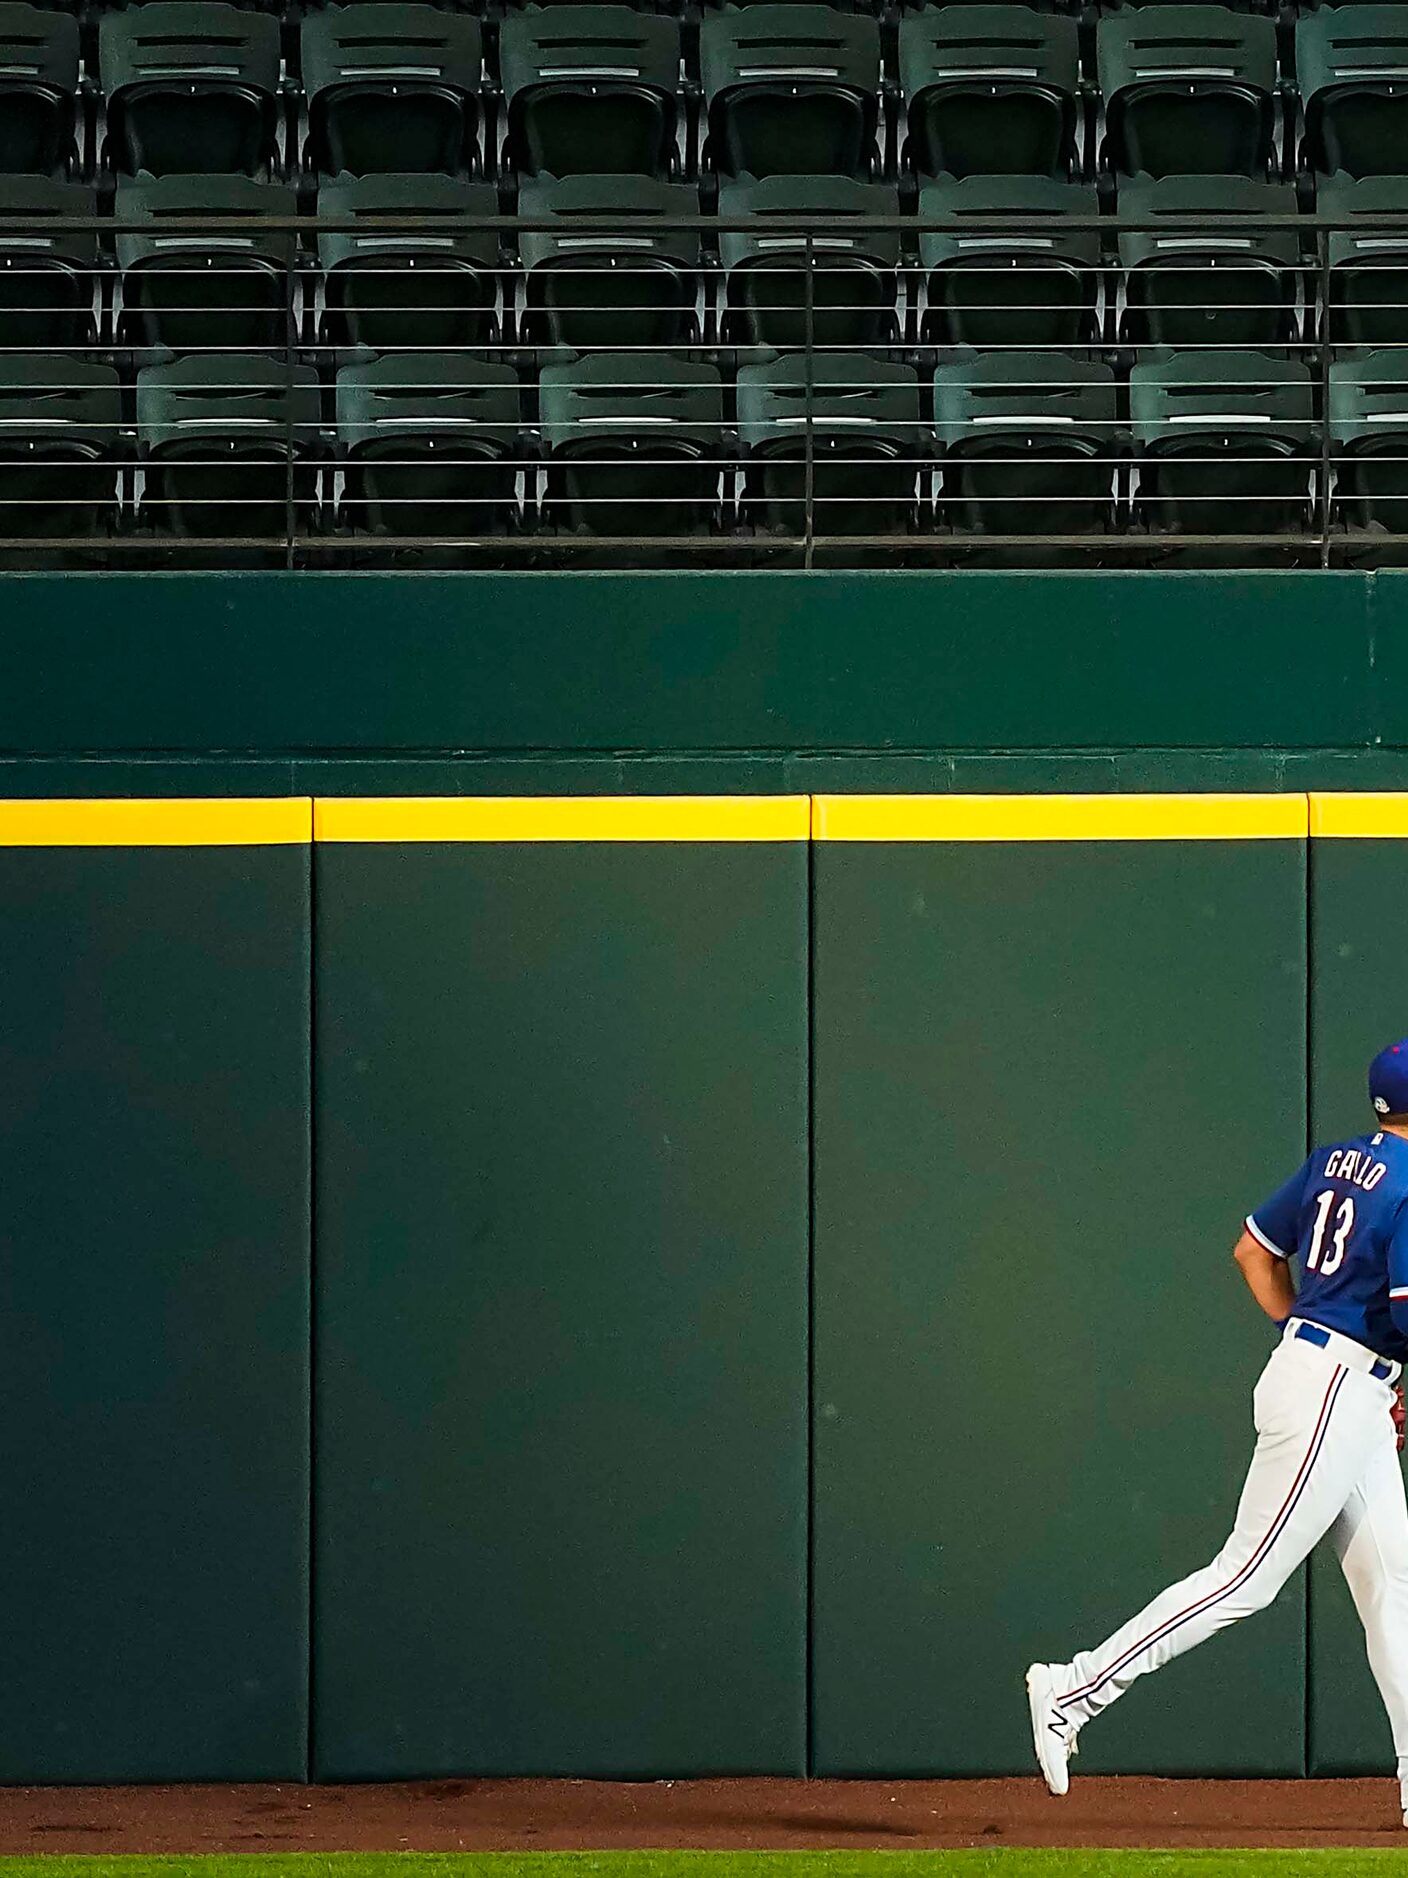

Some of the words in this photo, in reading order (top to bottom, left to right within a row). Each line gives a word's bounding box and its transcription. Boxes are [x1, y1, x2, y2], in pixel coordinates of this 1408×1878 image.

[1324, 1149, 1387, 1191] GALLO
[1306, 1189, 1355, 1276] 13
[1047, 1708, 1069, 1740] N
